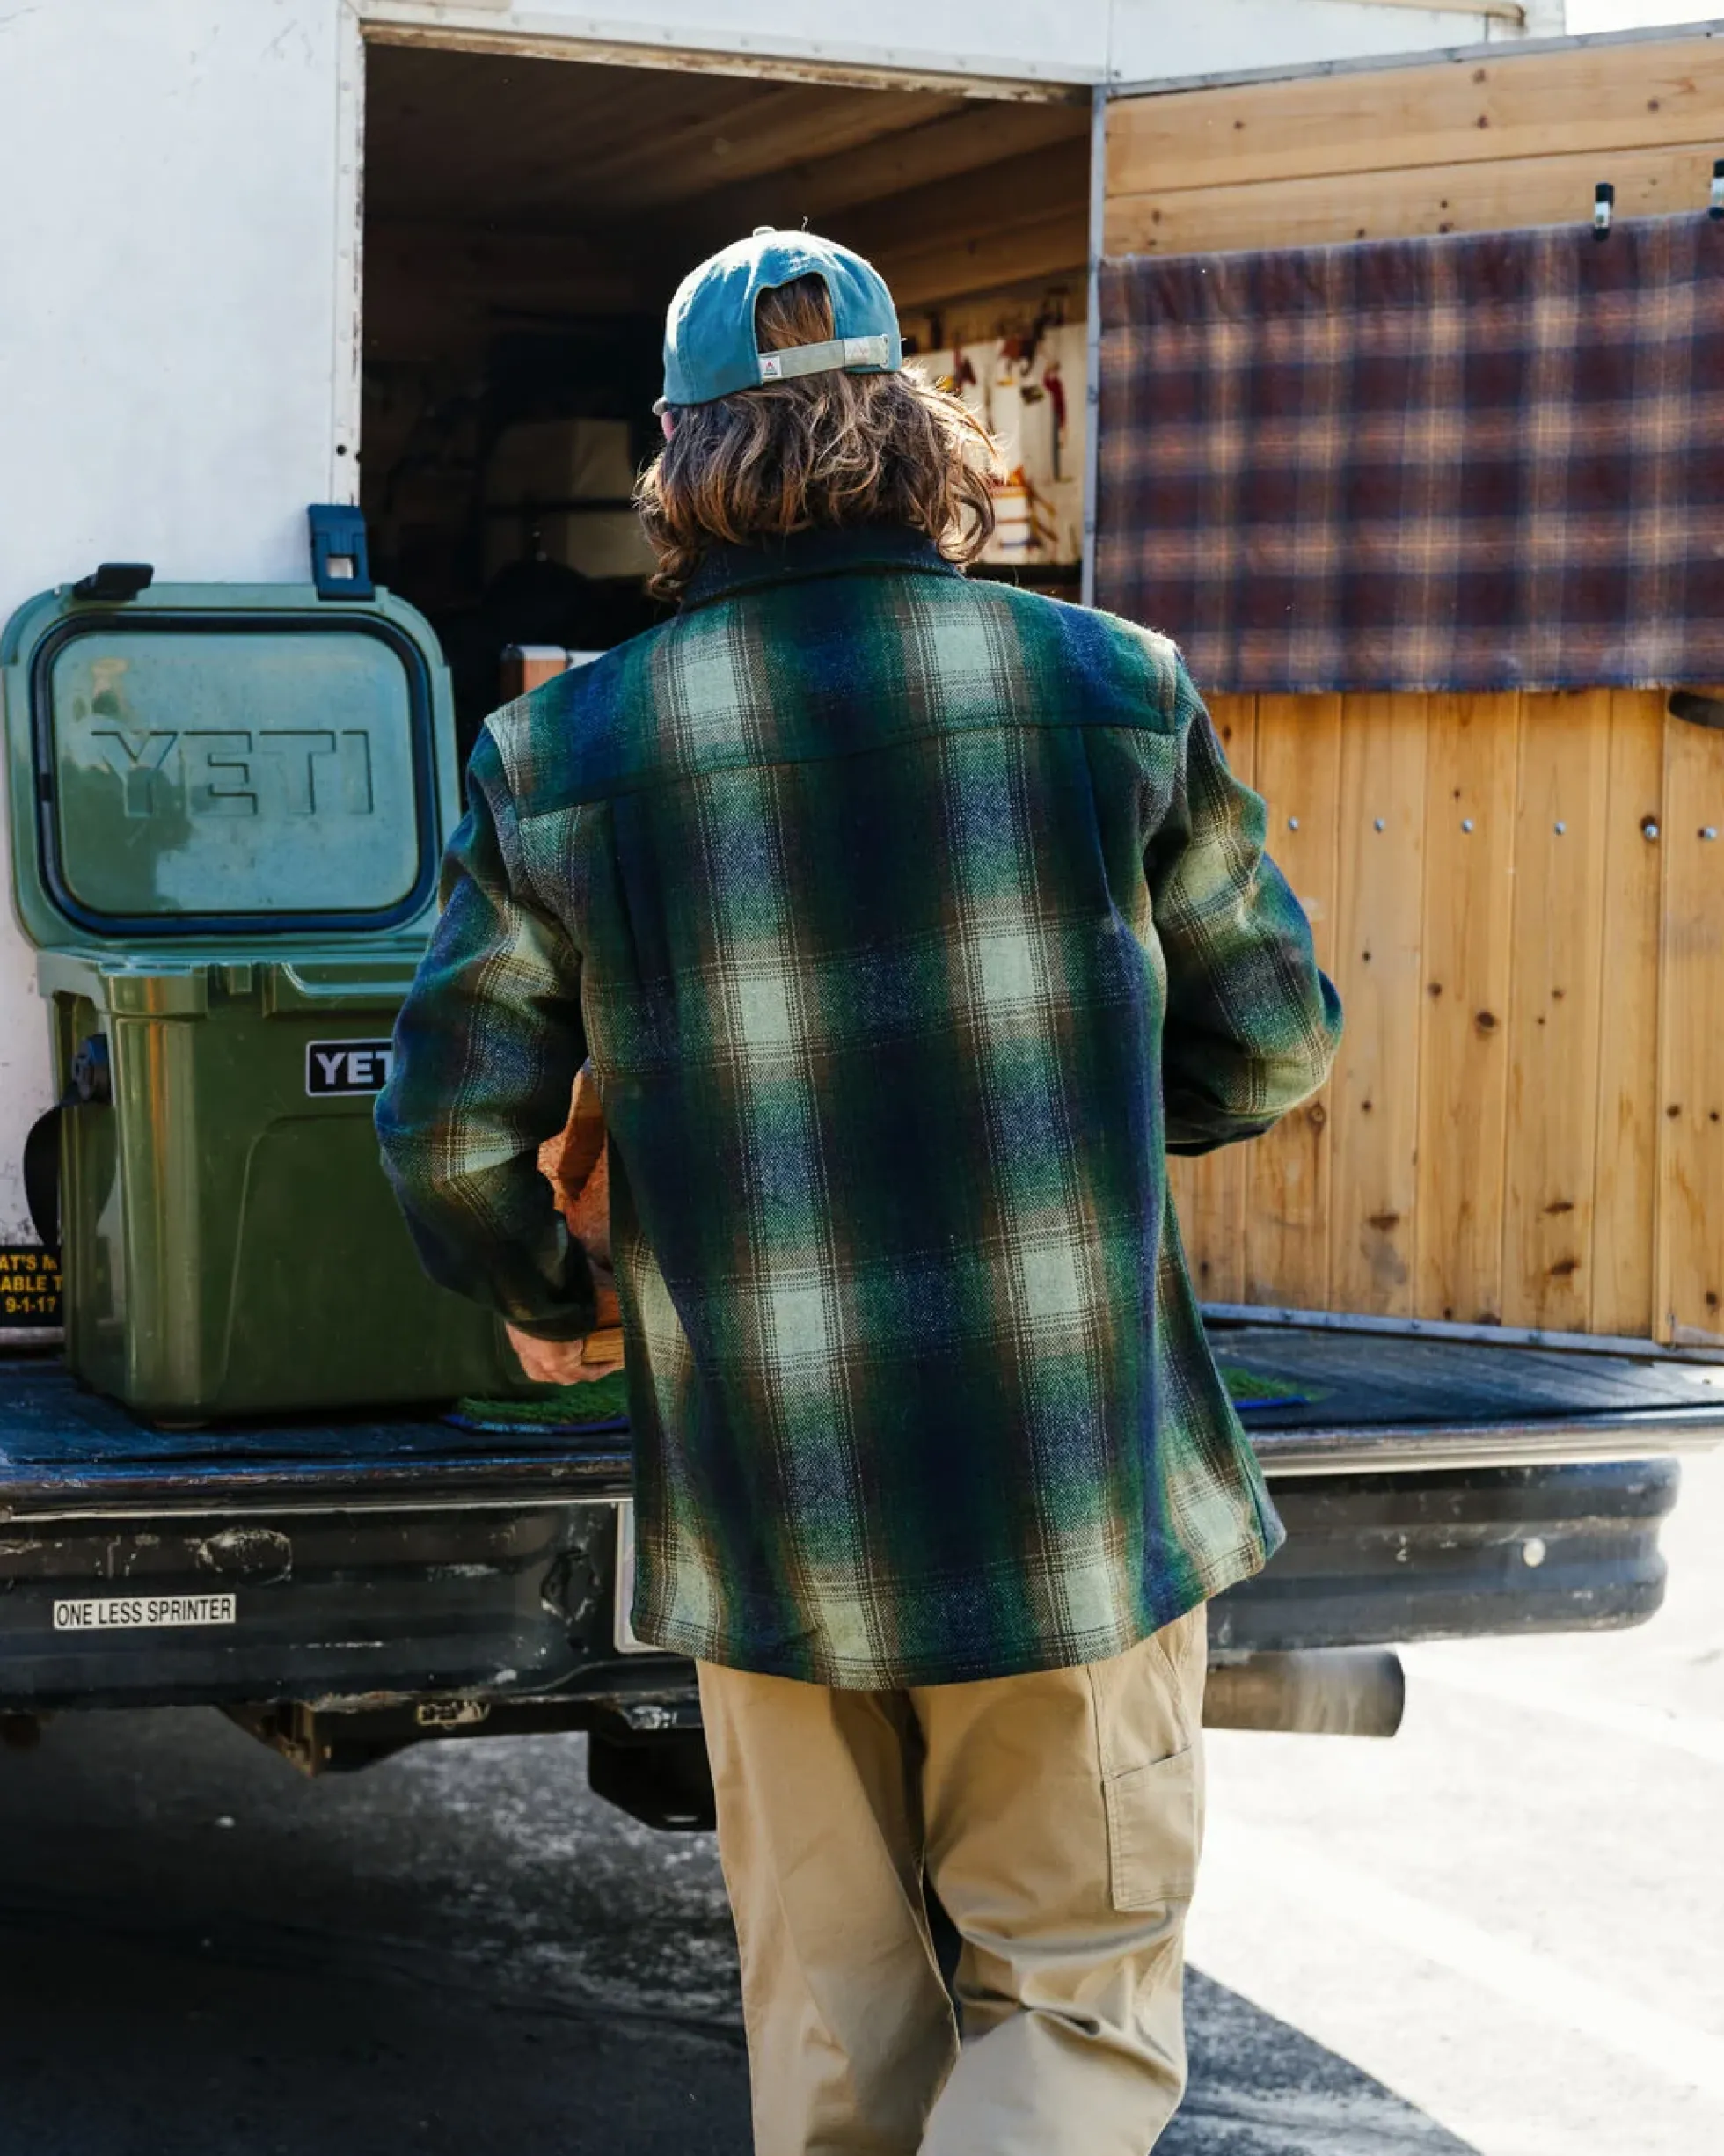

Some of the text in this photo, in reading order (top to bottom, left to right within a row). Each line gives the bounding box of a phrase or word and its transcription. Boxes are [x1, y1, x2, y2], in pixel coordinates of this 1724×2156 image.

[91, 730, 374, 818] YETI
[0, 1275, 47, 1292] ABLE
[5, 1296, 56, 1313] 9-1-17
[56, 1597, 232, 1626] ONE LESS SPRINTER
